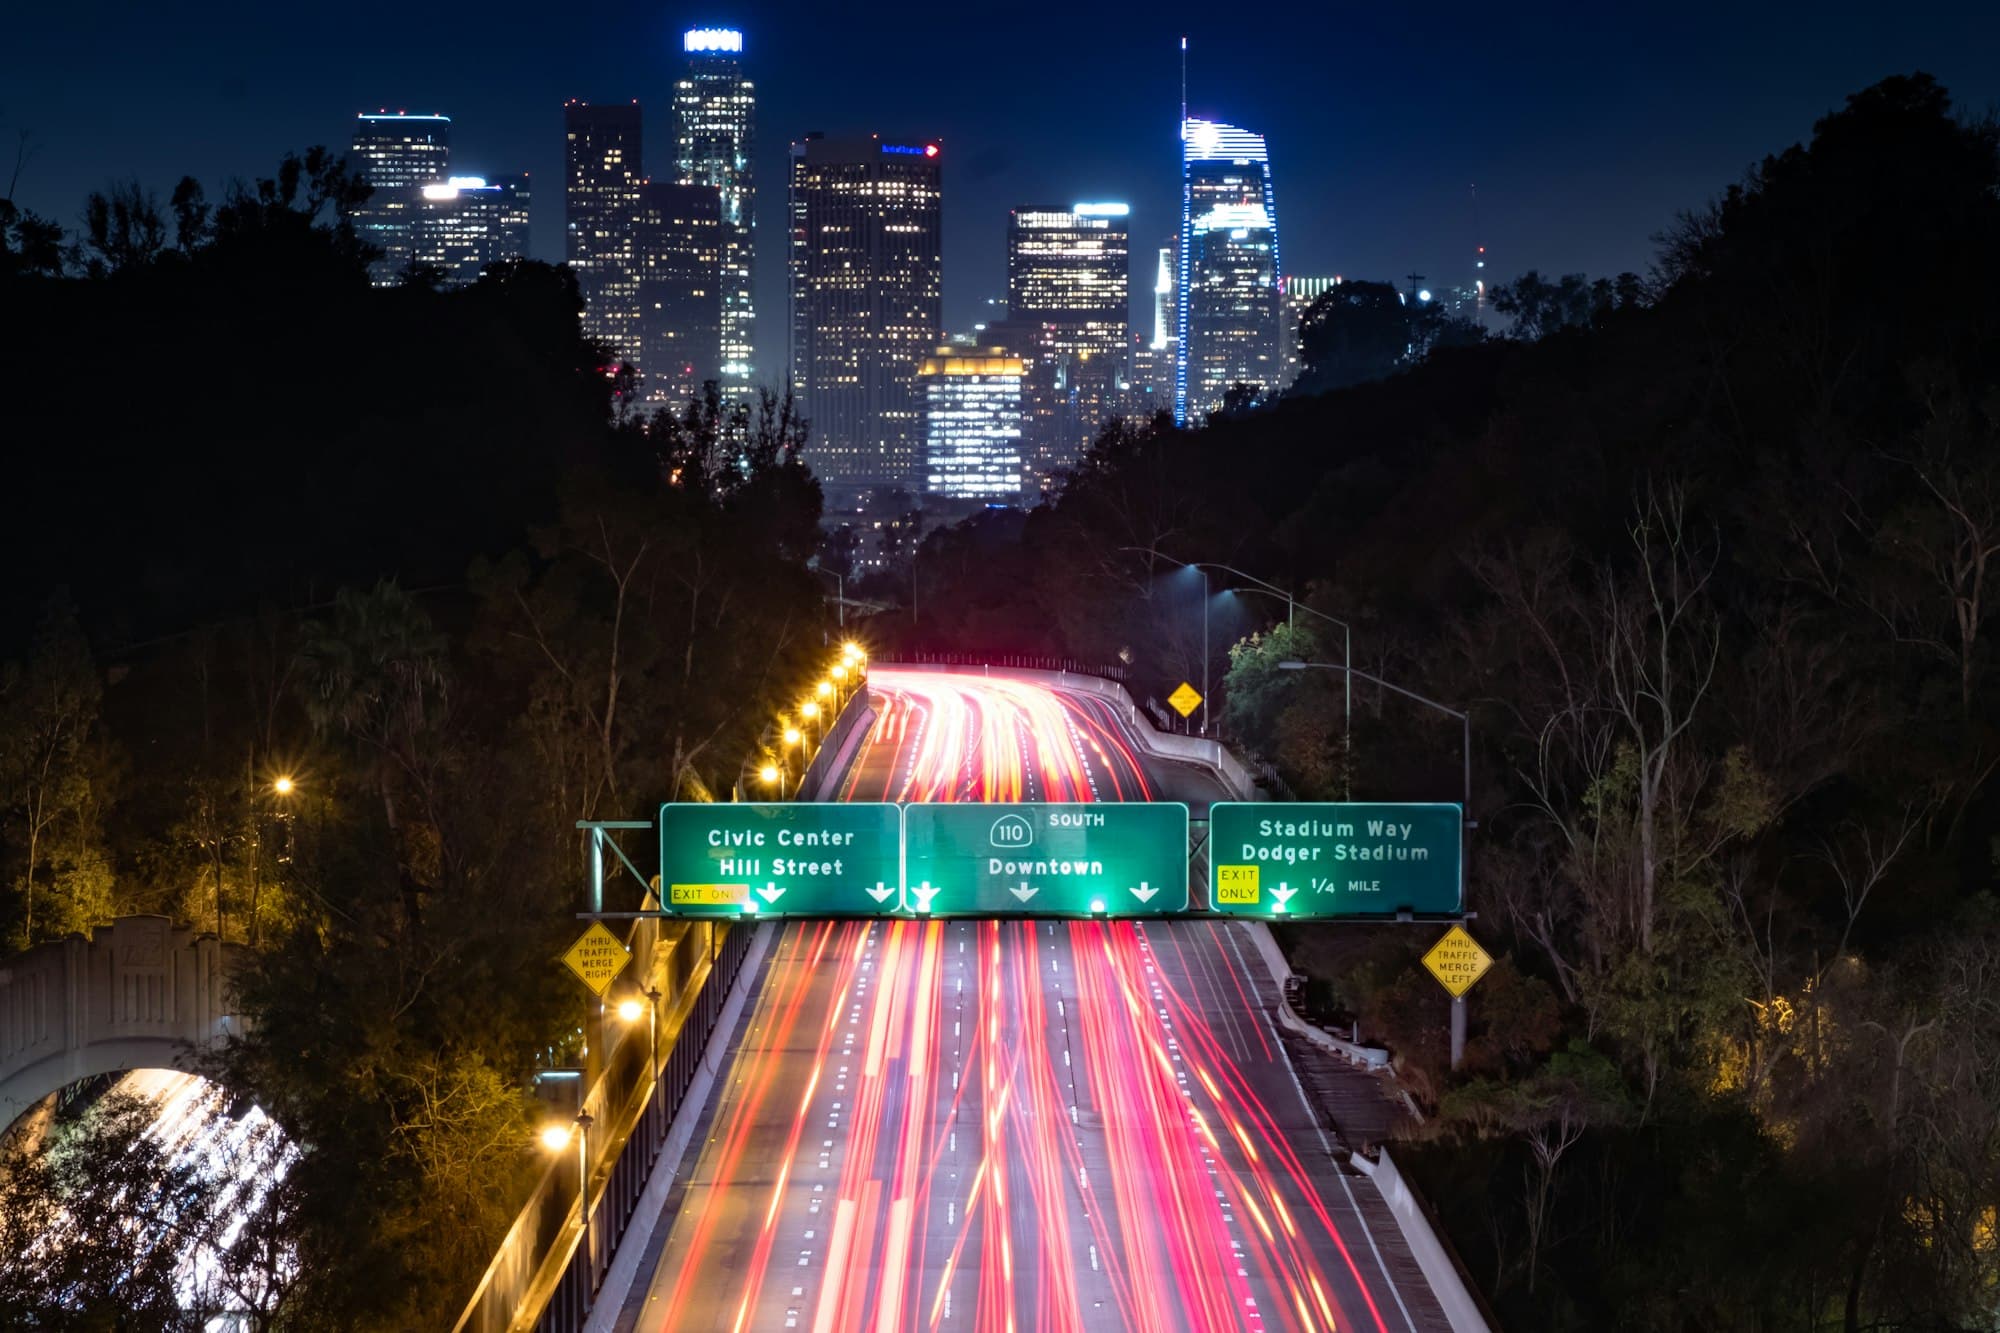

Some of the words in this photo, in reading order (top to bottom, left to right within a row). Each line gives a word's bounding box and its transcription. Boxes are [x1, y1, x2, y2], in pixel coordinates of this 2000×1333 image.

[1050, 813, 1104, 826] SOUTH
[1000, 825, 1023, 841] 110
[1259, 820, 1353, 837] Stadium
[1367, 820, 1412, 840] Way
[708, 829, 765, 846] Civic
[777, 829, 854, 846] Center
[1242, 844, 1321, 865] Dodger
[1334, 844, 1428, 860] Stadium
[720, 859, 760, 876] Hill
[772, 858, 843, 876] Street
[989, 858, 1103, 875] Downtown
[1221, 870, 1255, 881] EXIT
[1348, 881, 1380, 892] MILE
[673, 889, 703, 900] EXIT
[1220, 888, 1255, 899] ONLY
[585, 937, 611, 946] THRU
[1446, 939, 1470, 948] THRU
[578, 948, 618, 957] TRAFFIC
[1438, 951, 1478, 960] TRAFFIC
[582, 959, 614, 968] MERGE
[1440, 963, 1477, 972] MERGE
[585, 970, 612, 979] RIGHT
[1445, 975, 1471, 983] LEFT
